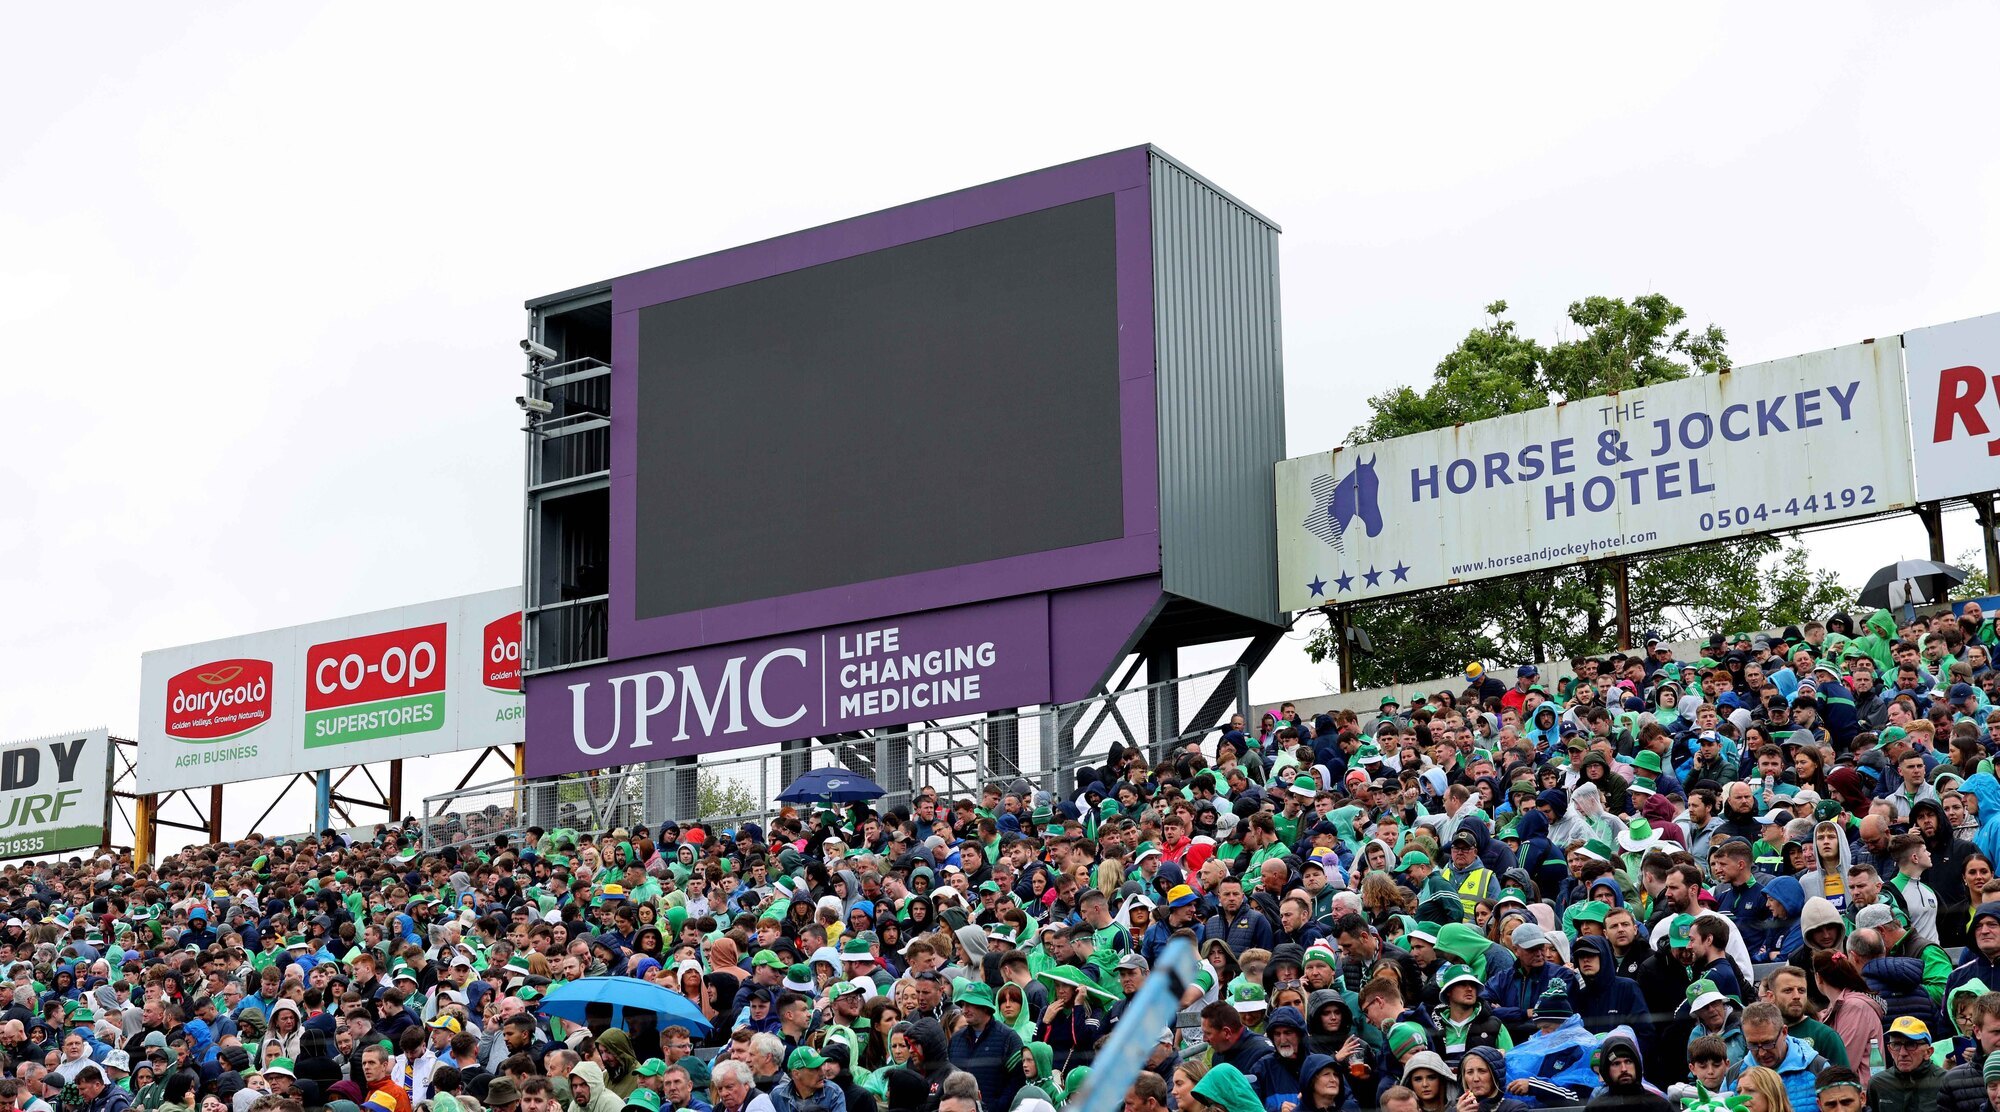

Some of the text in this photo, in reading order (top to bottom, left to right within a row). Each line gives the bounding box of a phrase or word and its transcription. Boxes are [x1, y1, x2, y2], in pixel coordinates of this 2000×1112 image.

[1599, 400, 1646, 426] THE
[1411, 381, 1861, 503] HORSE & JOCKEY
[1545, 458, 1716, 521] HOTEL
[1699, 484, 1876, 532] 0504-44192
[1452, 529, 1657, 575] www.horseandjockeyhotel.com
[839, 627, 900, 660] LIFE
[490, 671, 513, 681] Golden
[839, 641, 996, 689] CHANGING
[495, 705, 525, 722] AGRI
[567, 647, 808, 755] UPMC
[840, 674, 981, 719] MEDICINE
[171, 722, 191, 730] Golden
[214, 713, 237, 724] Growing
[238, 709, 265, 720] Naturally
[315, 703, 433, 737] SUPERSTORES
[175, 744, 258, 769] AGRI BUSINESS
